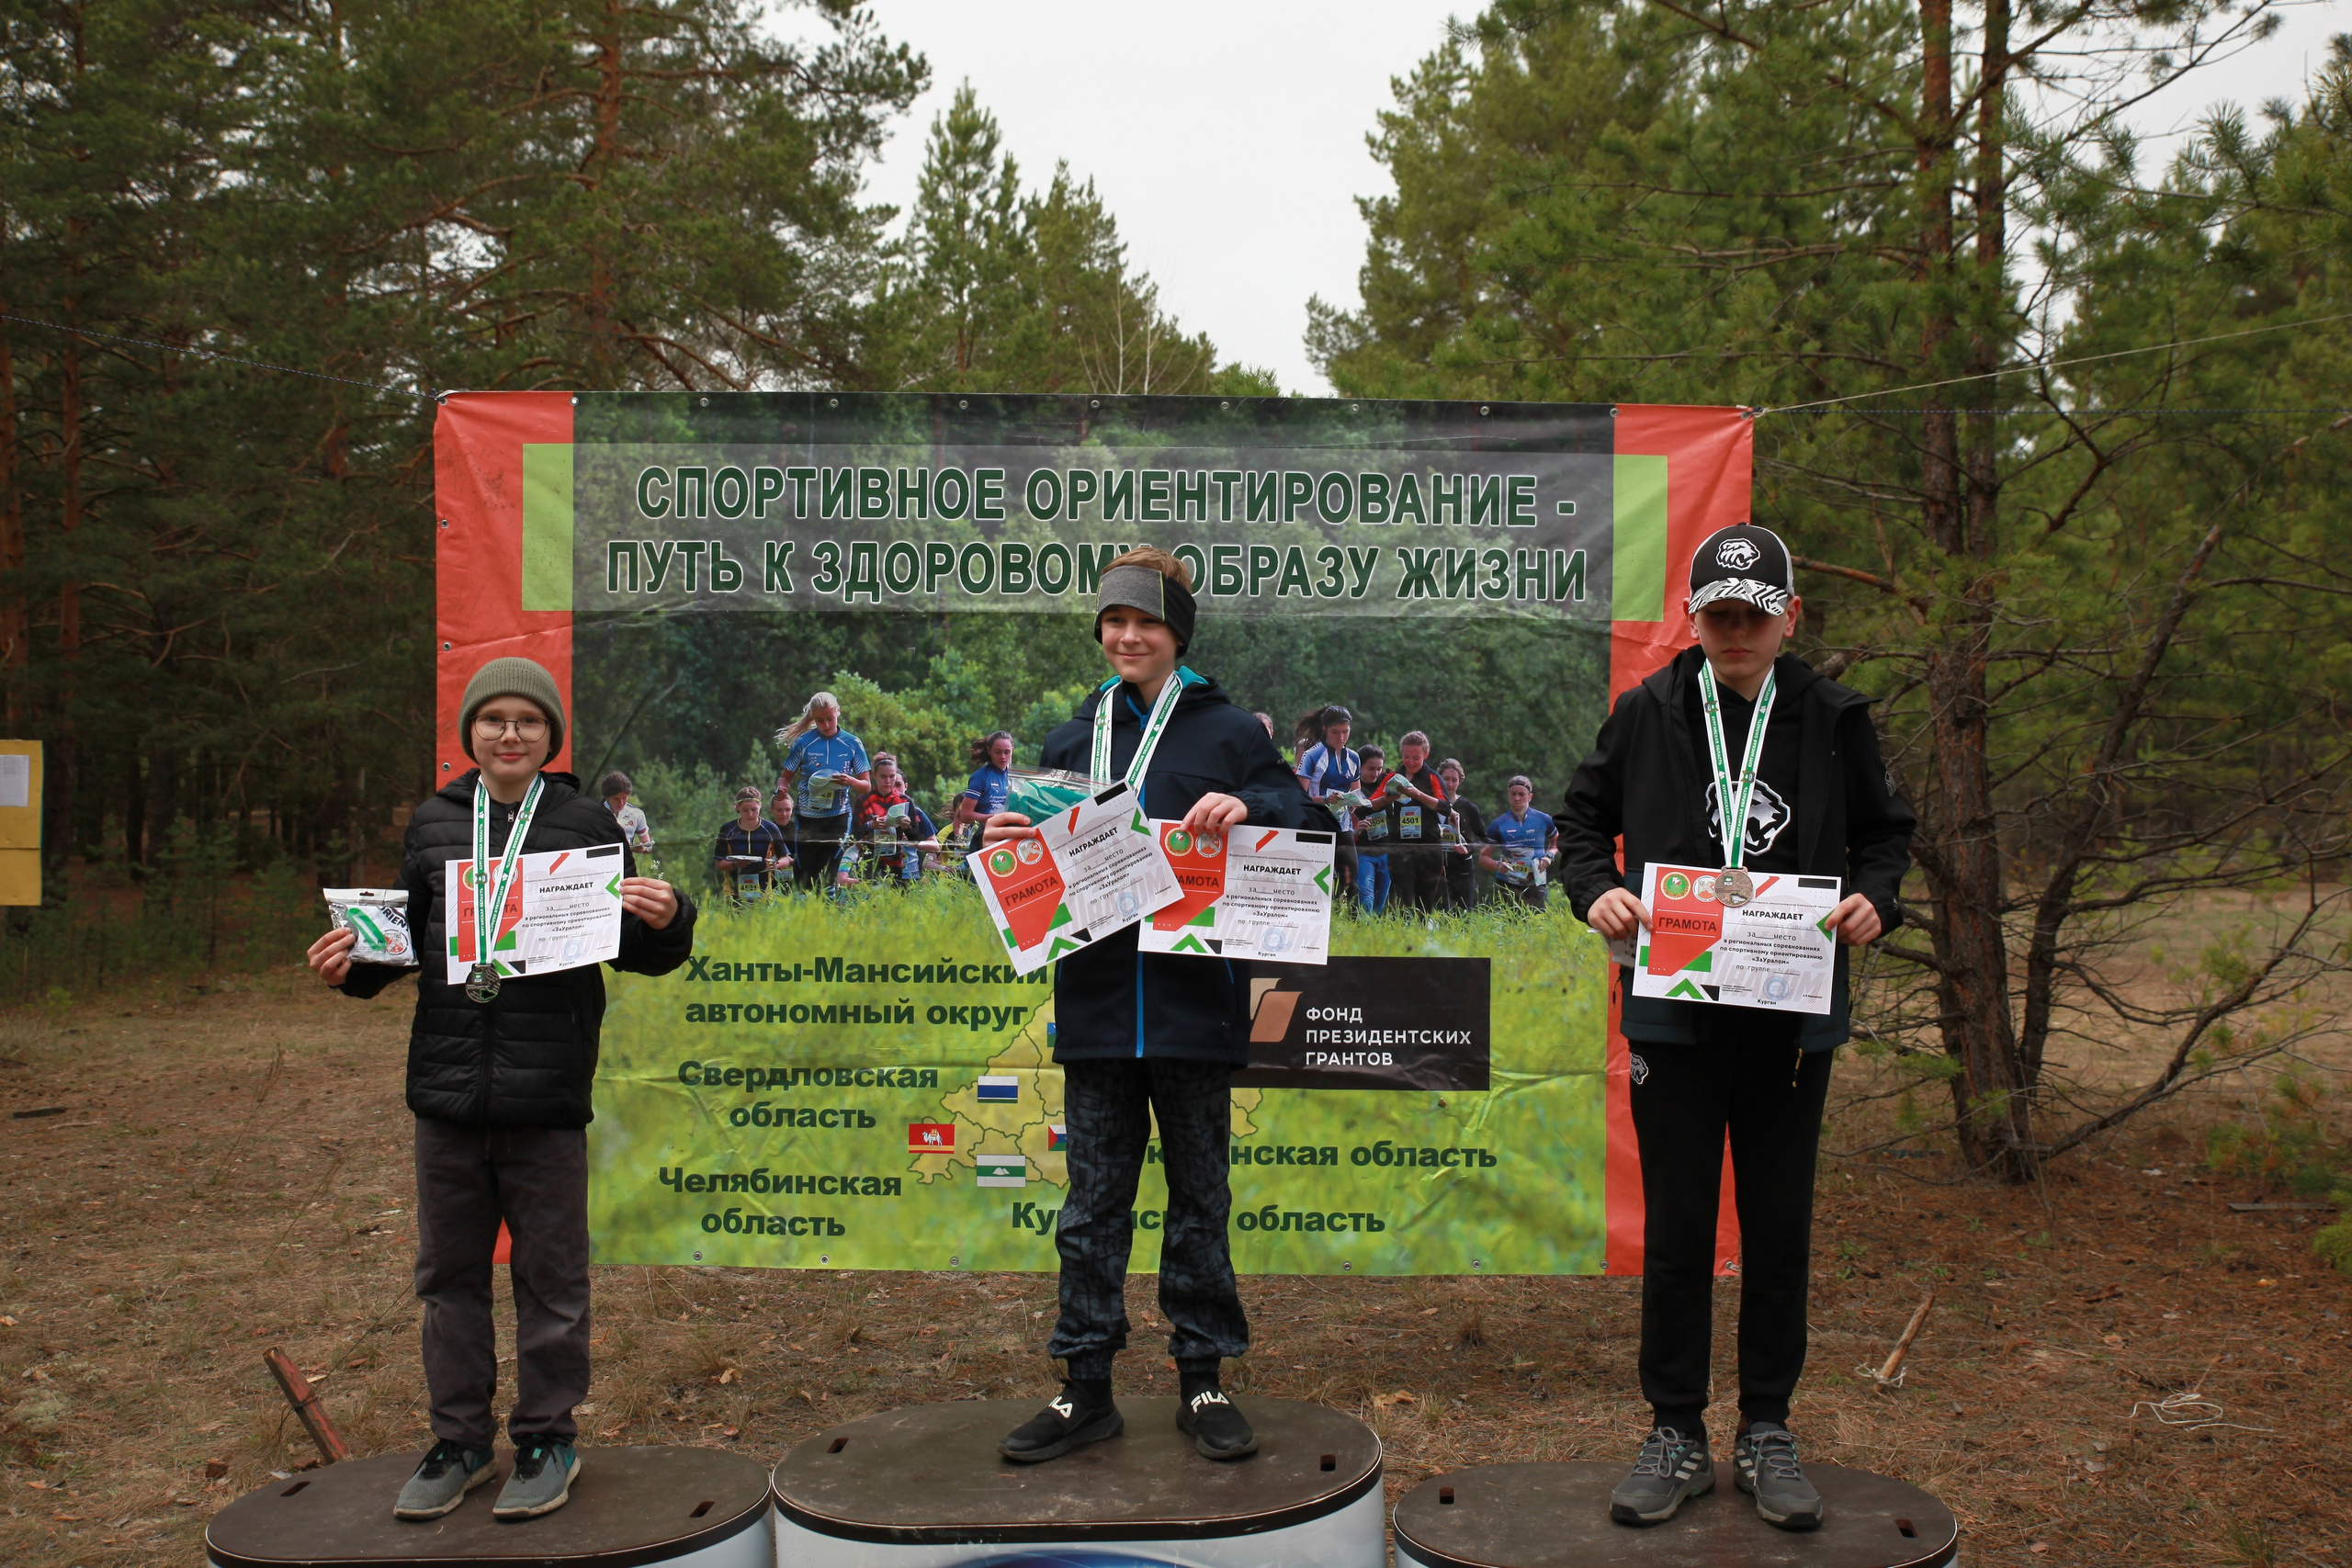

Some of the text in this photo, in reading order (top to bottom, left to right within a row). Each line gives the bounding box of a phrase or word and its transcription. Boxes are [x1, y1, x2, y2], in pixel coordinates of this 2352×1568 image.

[638, 466, 1576, 528] СПОРТИВНОЕ ОРИЕНТИРОВАНИЕ -
[607, 540, 1587, 604] ПУТЬ К ЗДОРОВОМ ОБРАЗУ ЖИЗНИ
[1401, 817, 1419, 825] 4501
[1069, 827, 1118, 857] НАГРАЖДАЕТ
[1104, 849, 1124, 862] место
[1072, 866, 1108, 889] региональных
[1109, 846, 1147, 869] соревнованиях
[1076, 874, 1110, 894] спортивному
[1110, 852, 1153, 877] ориентированию
[1243, 864, 1302, 874] НАГРАЖДАЕТ
[539, 882, 594, 893] НАГРАЖДАЕТ
[1175, 874, 1219, 887] АМОТА
[1004, 876, 1058, 907] ГРАМОТА
[1100, 888, 1118, 902] группе
[463, 904, 517, 918] ГРТА
[1230, 902, 1269, 910] спортивному
[1270, 905, 1320, 913] ориентированию
[1742, 909, 1804, 920] НАГРАЖДАЕТ
[1122, 912, 1138, 923] Курган
[1658, 917, 1717, 931] ГРАМОТА
[1728, 939, 1772, 947] региональных
[1773, 942, 1820, 952] соревнованиях
[1773, 933, 1796, 942] место
[1729, 947, 1769, 955] спортивному
[1770, 951, 1823, 960] ориентированию
[684, 998, 1029, 1032] автономный округ
[1306, 1007, 1363, 1024] ФОНД
[1306, 1029, 1472, 1046] ПРЕЗИДЕНТСКИХ
[1305, 1052, 1394, 1066] ГРАНТОВ
[677, 1060, 939, 1093] Свердловская
[729, 1101, 876, 1129] область
[1148, 1140, 1497, 1168] юнская область
[659, 1167, 902, 1196] Челябинская
[701, 1208, 846, 1236] область
[1236, 1204, 1385, 1233] область
[1191, 1391, 1229, 1413] FILA
